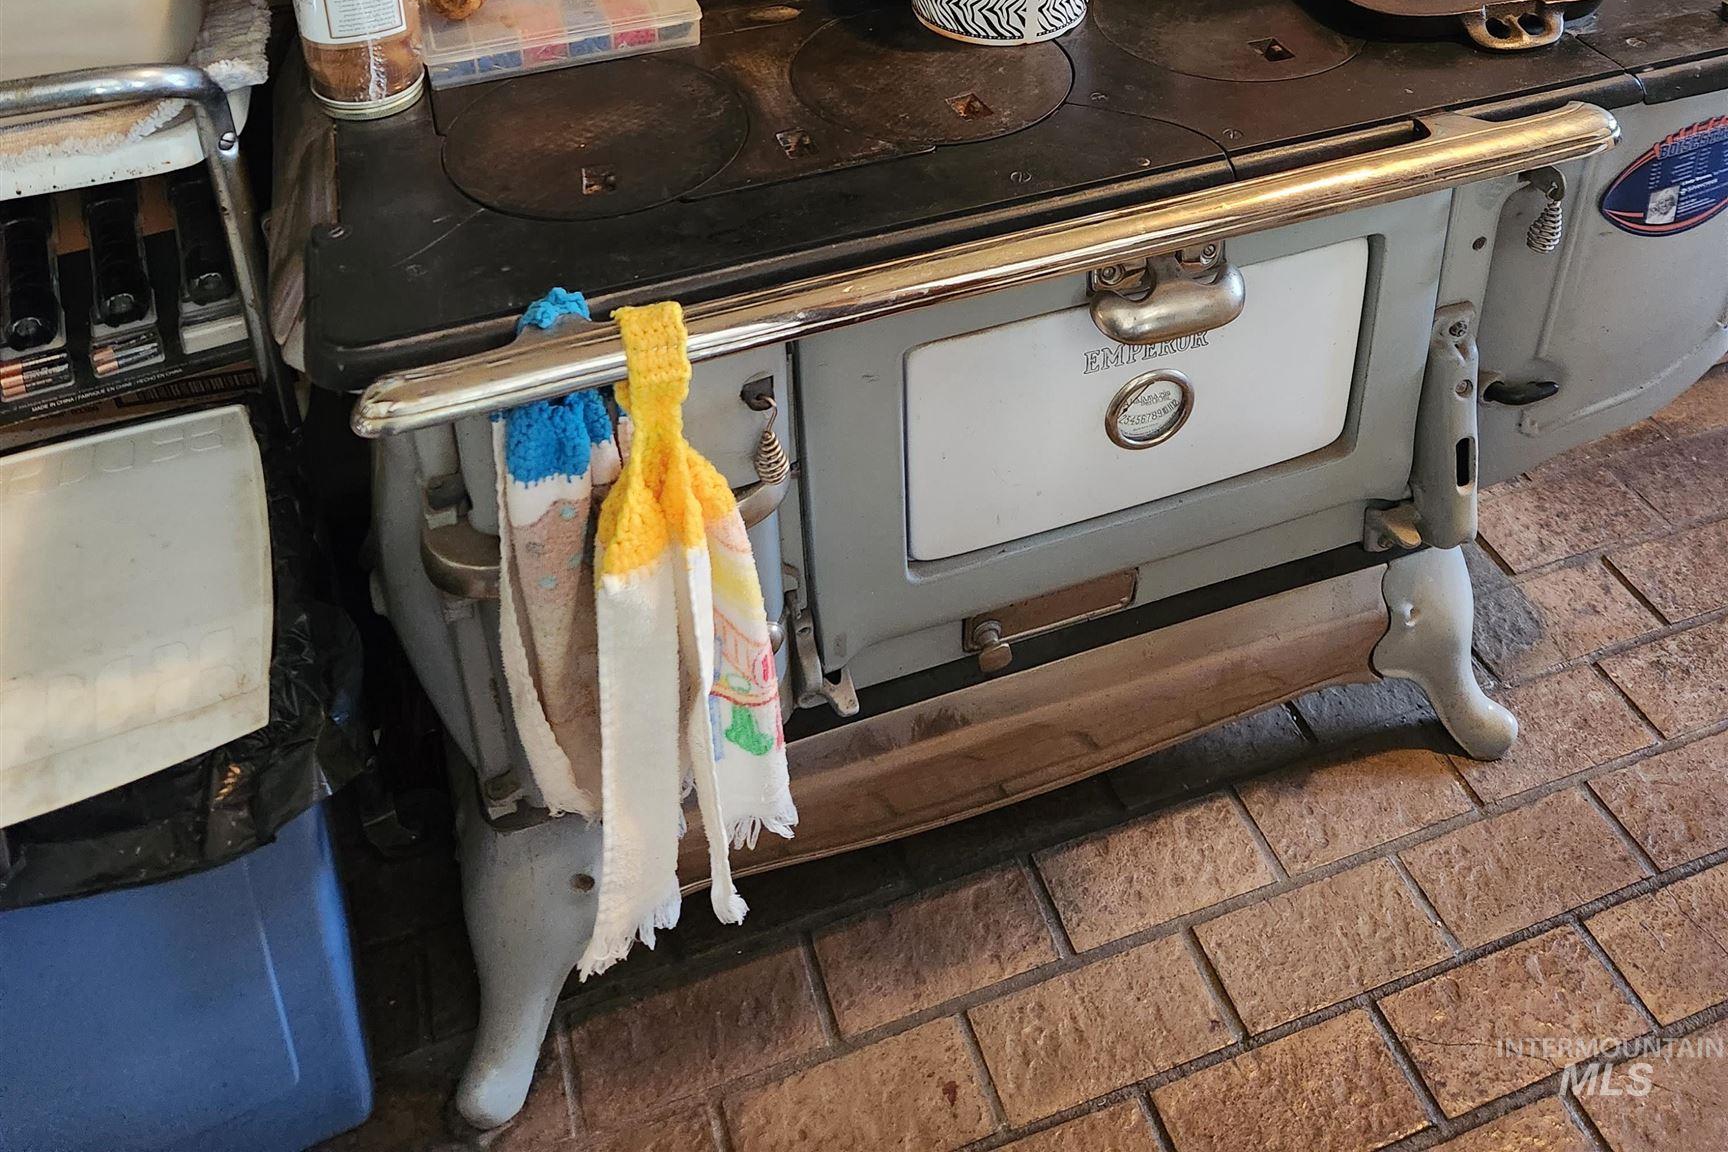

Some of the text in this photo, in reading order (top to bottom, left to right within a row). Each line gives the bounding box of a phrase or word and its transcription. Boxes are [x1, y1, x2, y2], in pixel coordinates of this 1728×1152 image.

[1084, 330, 1209, 374] EMPEROR
[32, 404, 48, 412] MADE
[56, 398, 74, 408] CHINA
[136, 376, 156, 384] HECHO
[166, 368, 183, 378] CHINA
